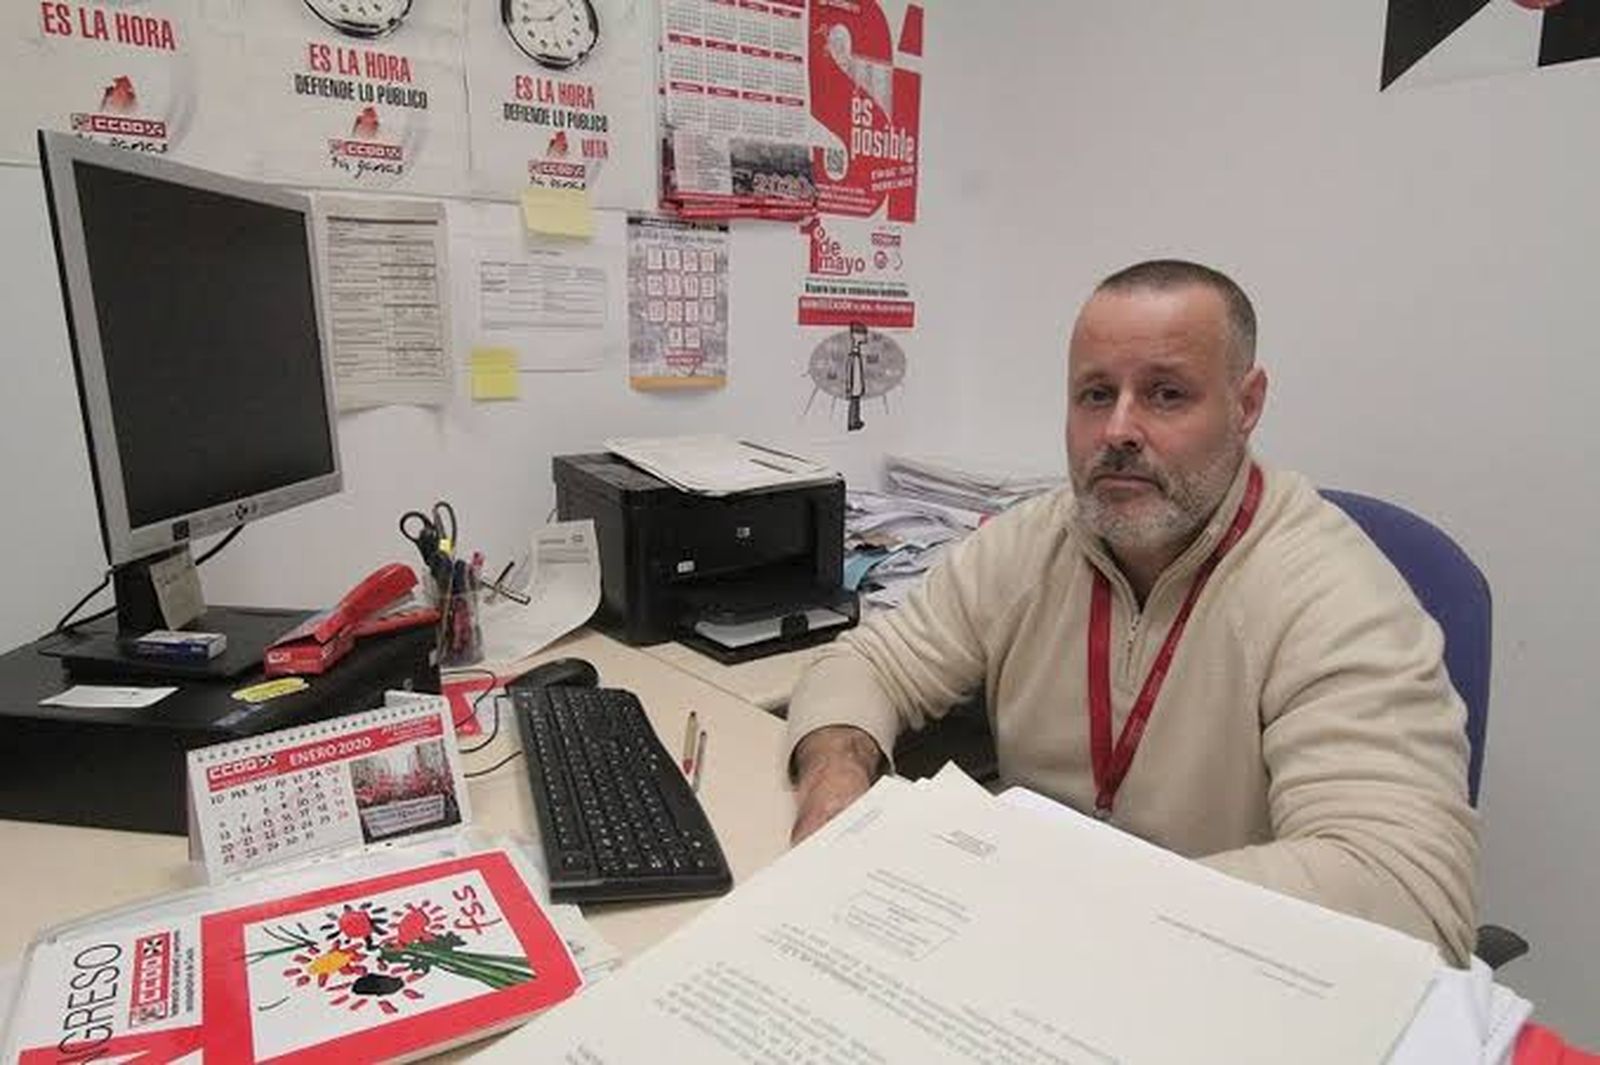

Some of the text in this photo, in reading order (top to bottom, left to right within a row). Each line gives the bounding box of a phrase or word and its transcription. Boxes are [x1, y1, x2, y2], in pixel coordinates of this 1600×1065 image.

[41, 2, 176, 51] ES LA HORA
[309, 43, 412, 83] ES LA HORA
[294, 73, 354, 100] DEFIENDE
[358, 83, 374, 102] LO
[515, 75, 595, 110] ES LA HORA
[503, 102, 551, 127] DEFIENDE
[851, 97, 874, 127] es
[581, 138, 609, 159] VOTA
[851, 122, 915, 164] posible
[820, 238, 841, 257] de
[819, 256, 866, 276] mayo
[289, 744, 337, 767] ENERO
[339, 736, 372, 755] 2020
